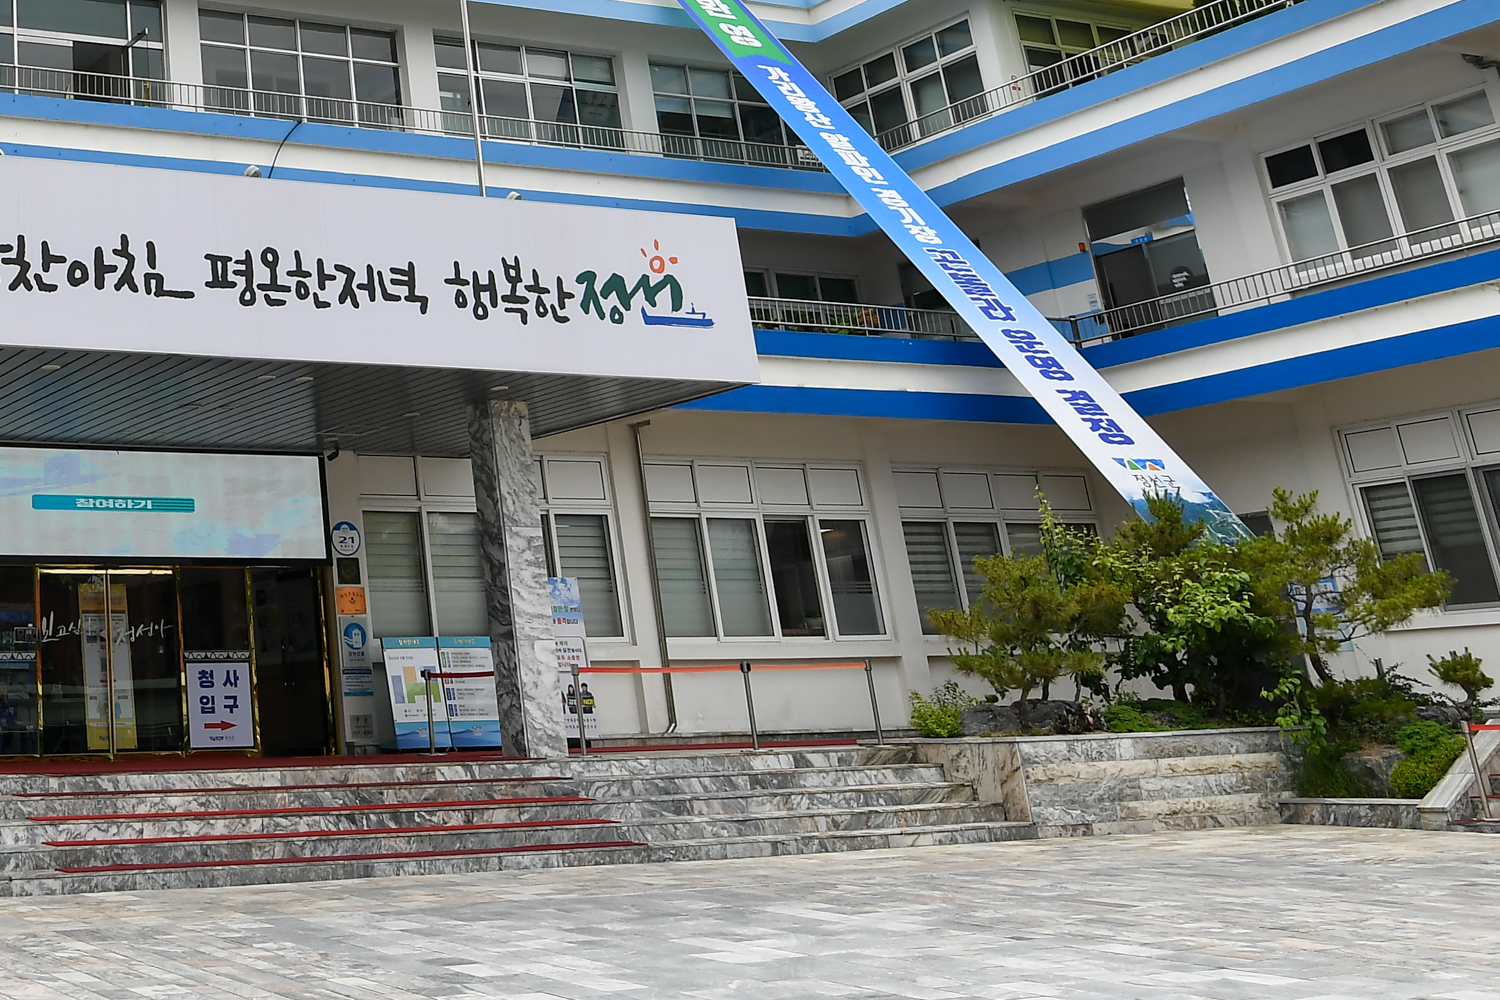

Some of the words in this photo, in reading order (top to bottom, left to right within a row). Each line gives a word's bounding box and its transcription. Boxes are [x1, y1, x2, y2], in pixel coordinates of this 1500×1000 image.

[757, 64, 835, 130] 가리왕산
[819, 131, 889, 185] 알파인
[872, 188, 942, 245] 경기장
[1001, 327, 1075, 382] 운영
[1131, 473, 1177, 489] 정선군
[75, 497, 153, 510] 참여하기
[338, 536, 355, 544] 21
[198, 669, 239, 688] 청사
[199, 695, 239, 714] 입구
